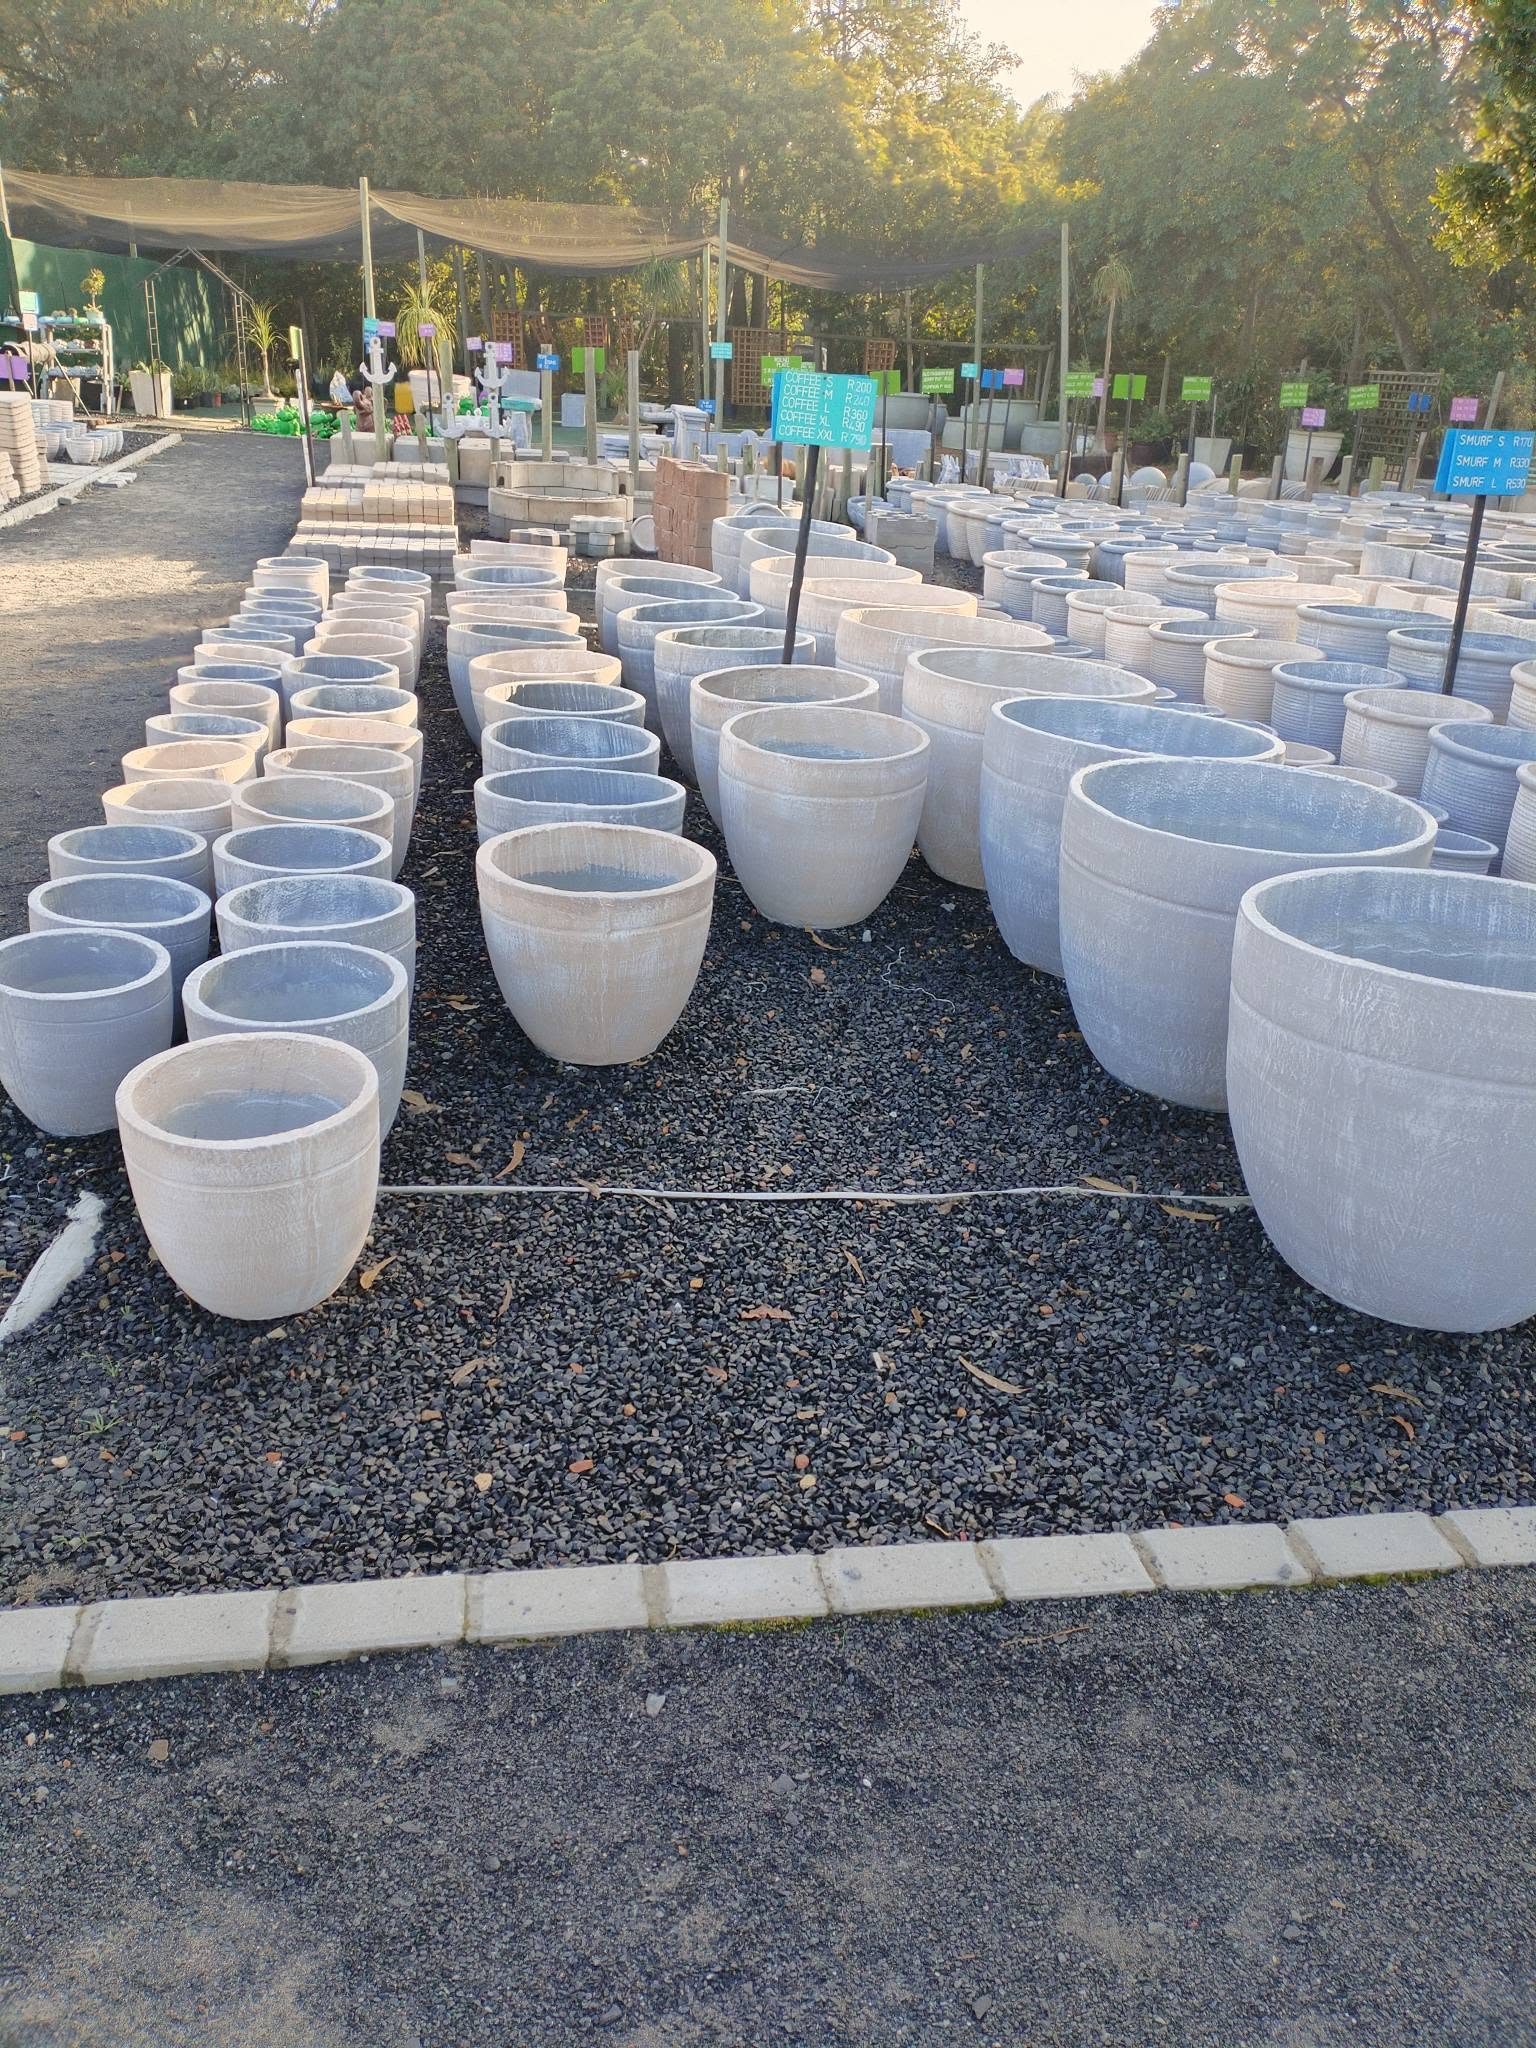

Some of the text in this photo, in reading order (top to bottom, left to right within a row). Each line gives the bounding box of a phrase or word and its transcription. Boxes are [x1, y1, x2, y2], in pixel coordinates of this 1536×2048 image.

[785, 371, 821, 387] COFFEE
[826, 376, 834, 388] S
[847, 379, 873, 393] R200
[783, 384, 821, 399] COFFEE
[824, 390, 833, 400] M
[782, 396, 868, 421] COFFEE L R360
[780, 410, 817, 425] COFFEE
[819, 416, 831, 427] XL
[779, 425, 816, 439] COFFEE
[817, 429, 835, 442] XXL
[1460, 434, 1533, 448] SMURF S R170
[1456, 455, 1531, 469] SMURF M R330
[1452, 476, 1486, 488] SMURF
[1491, 478, 1497, 489] L
